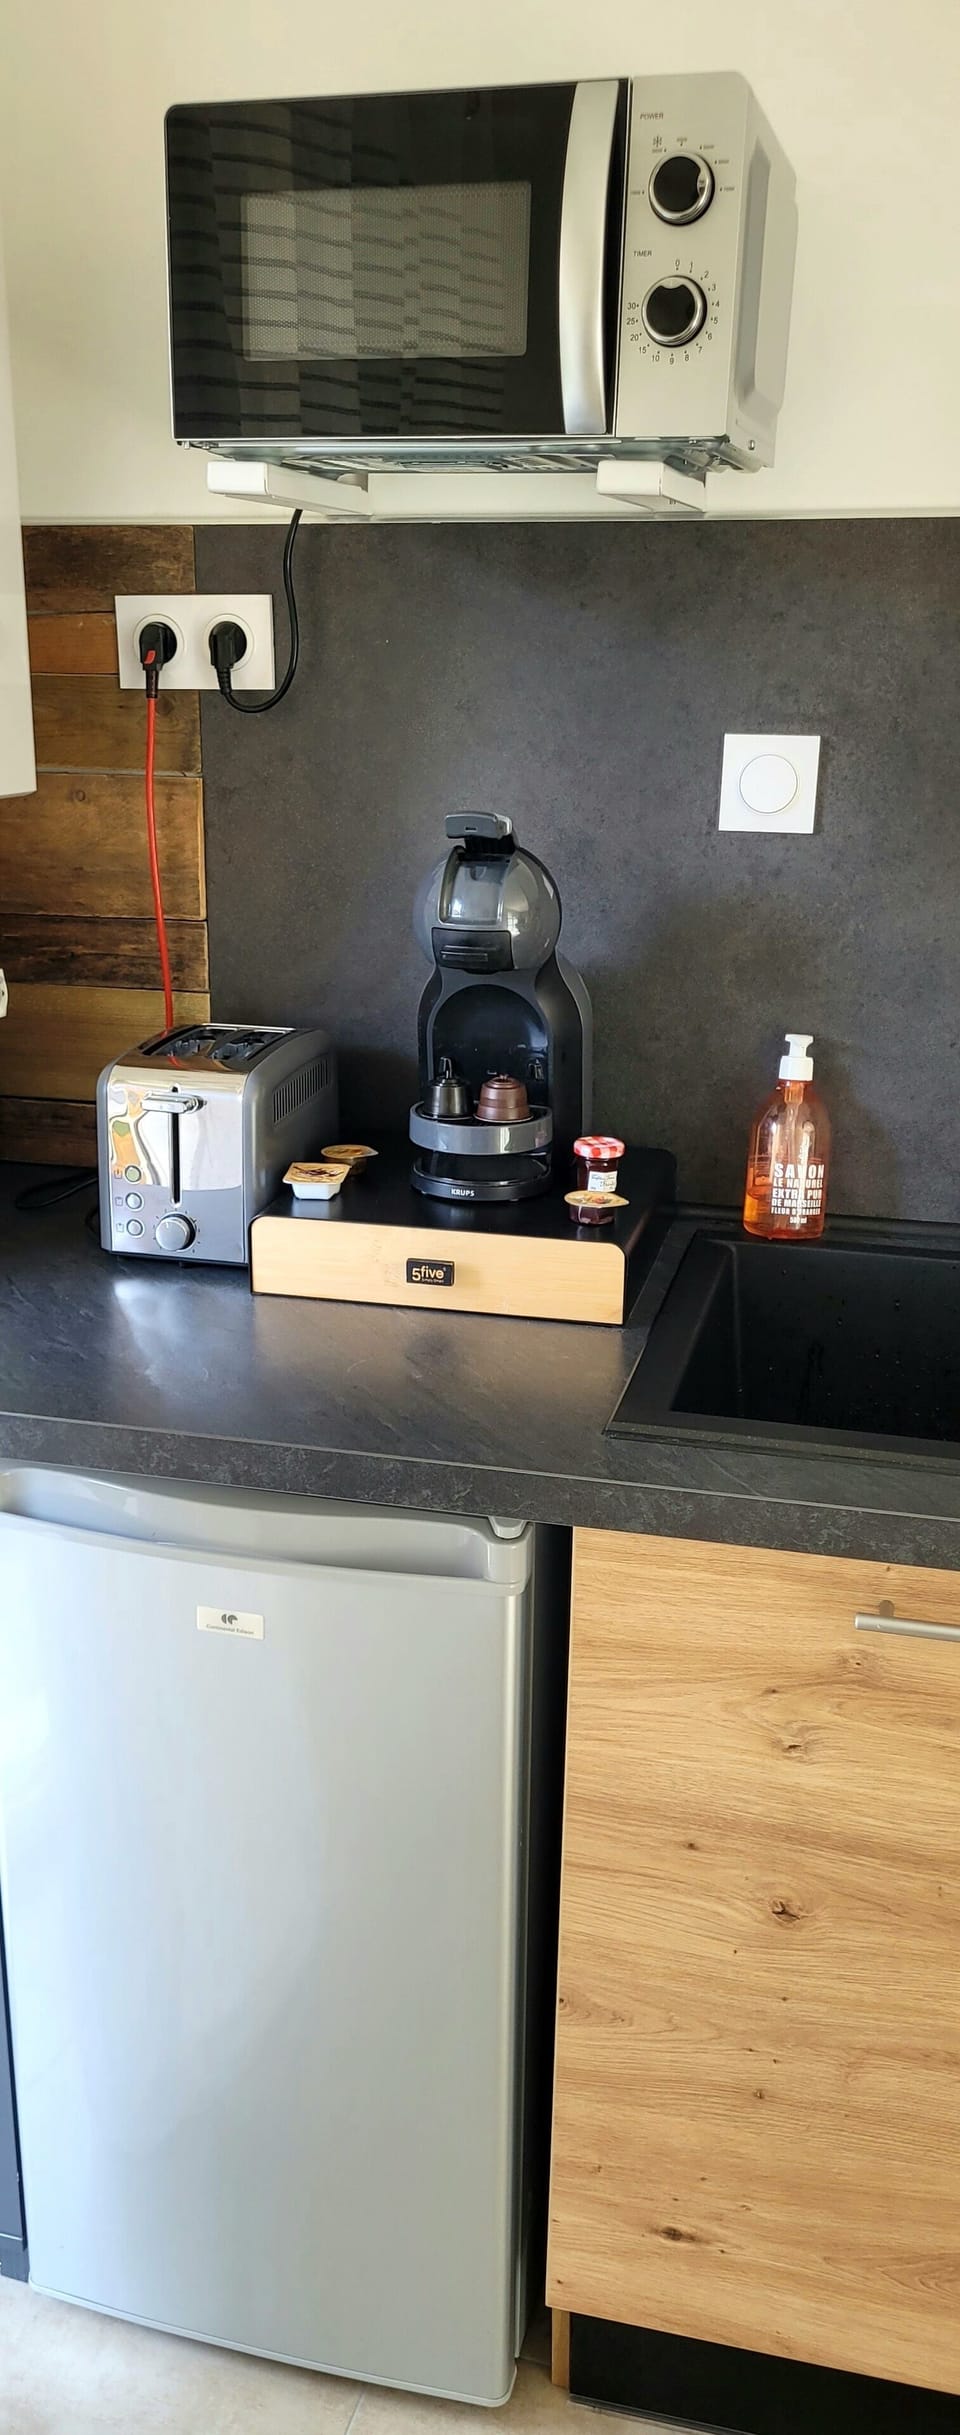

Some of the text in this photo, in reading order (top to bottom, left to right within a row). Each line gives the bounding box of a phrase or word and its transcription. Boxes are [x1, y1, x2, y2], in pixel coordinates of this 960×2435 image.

[640, 112, 664, 120] POWER
[704, 270, 710, 278] 2
[711, 283, 717, 292] 3
[627, 302, 637, 310] 30
[715, 300, 720, 308] 4
[626, 317, 636, 325] 25
[713, 317, 719, 325] 5
[630, 333, 639, 342] 20
[707, 332, 713, 341] 6
[639, 346, 647, 354] 15
[652, 354, 660, 362] 10
[669, 357, 675, 365] 9
[684, 354, 690, 362] 8
[774, 1163, 825, 1178] SAVON
[773, 1178, 823, 1188] LE NAUREL
[451, 1188, 475, 1197] KRUPS
